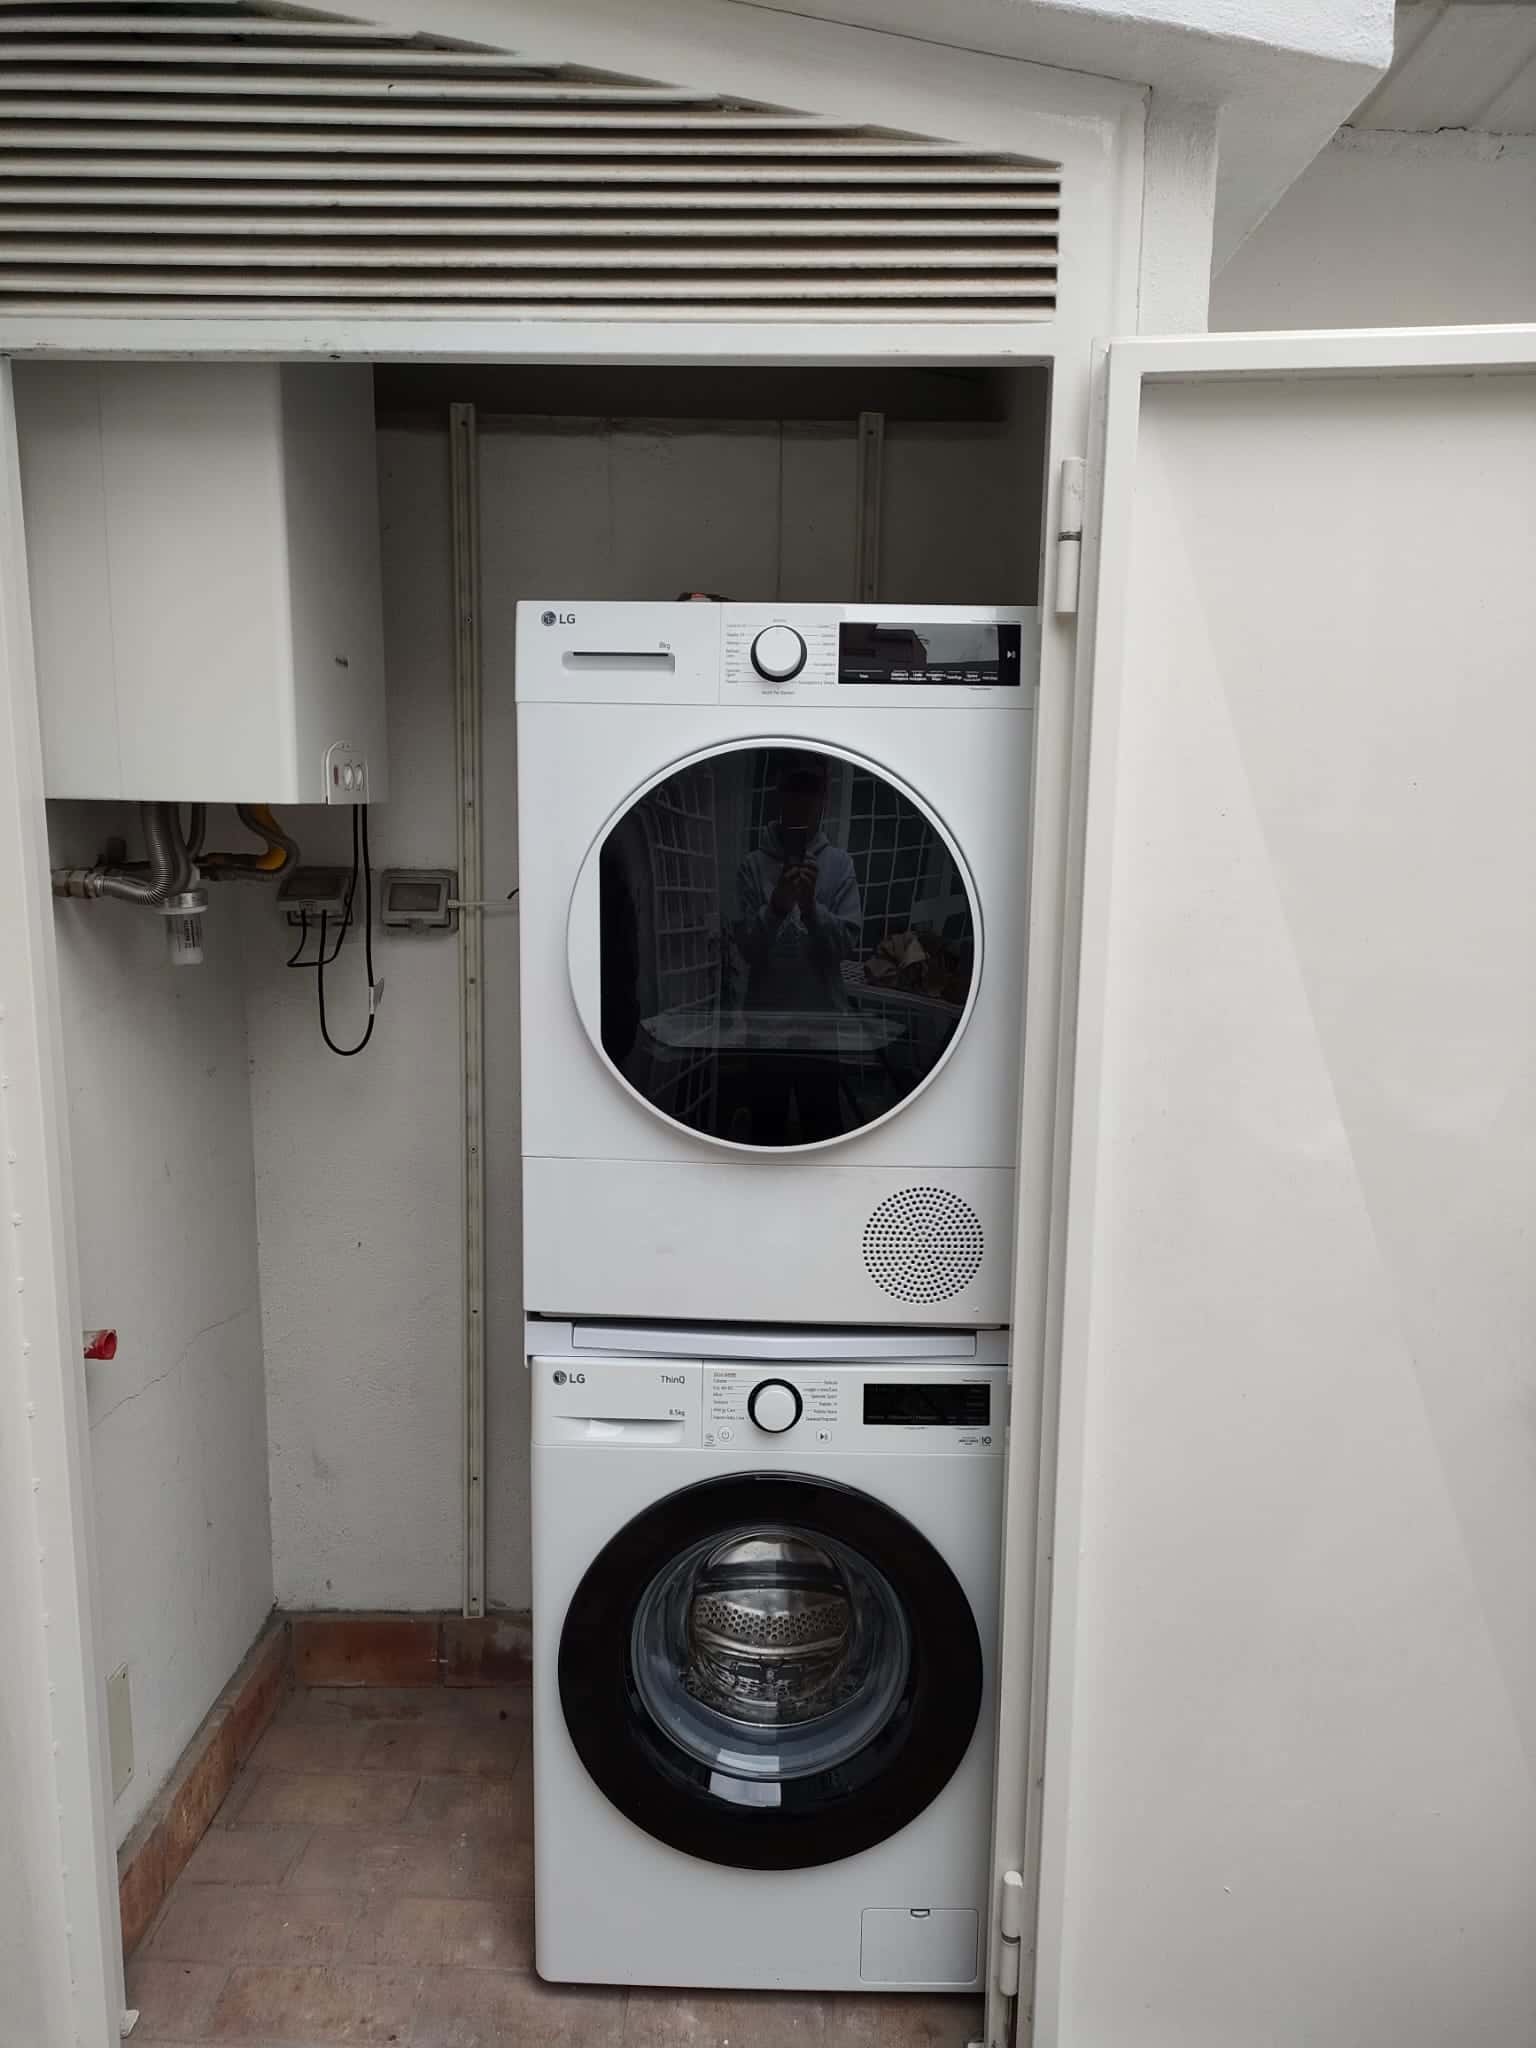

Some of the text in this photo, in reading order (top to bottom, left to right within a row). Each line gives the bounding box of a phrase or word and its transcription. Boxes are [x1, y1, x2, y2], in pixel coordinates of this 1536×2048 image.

[559, 613, 576, 624] LG
[569, 1373, 586, 1384] LG
[660, 1375, 686, 1384] ThinQ
